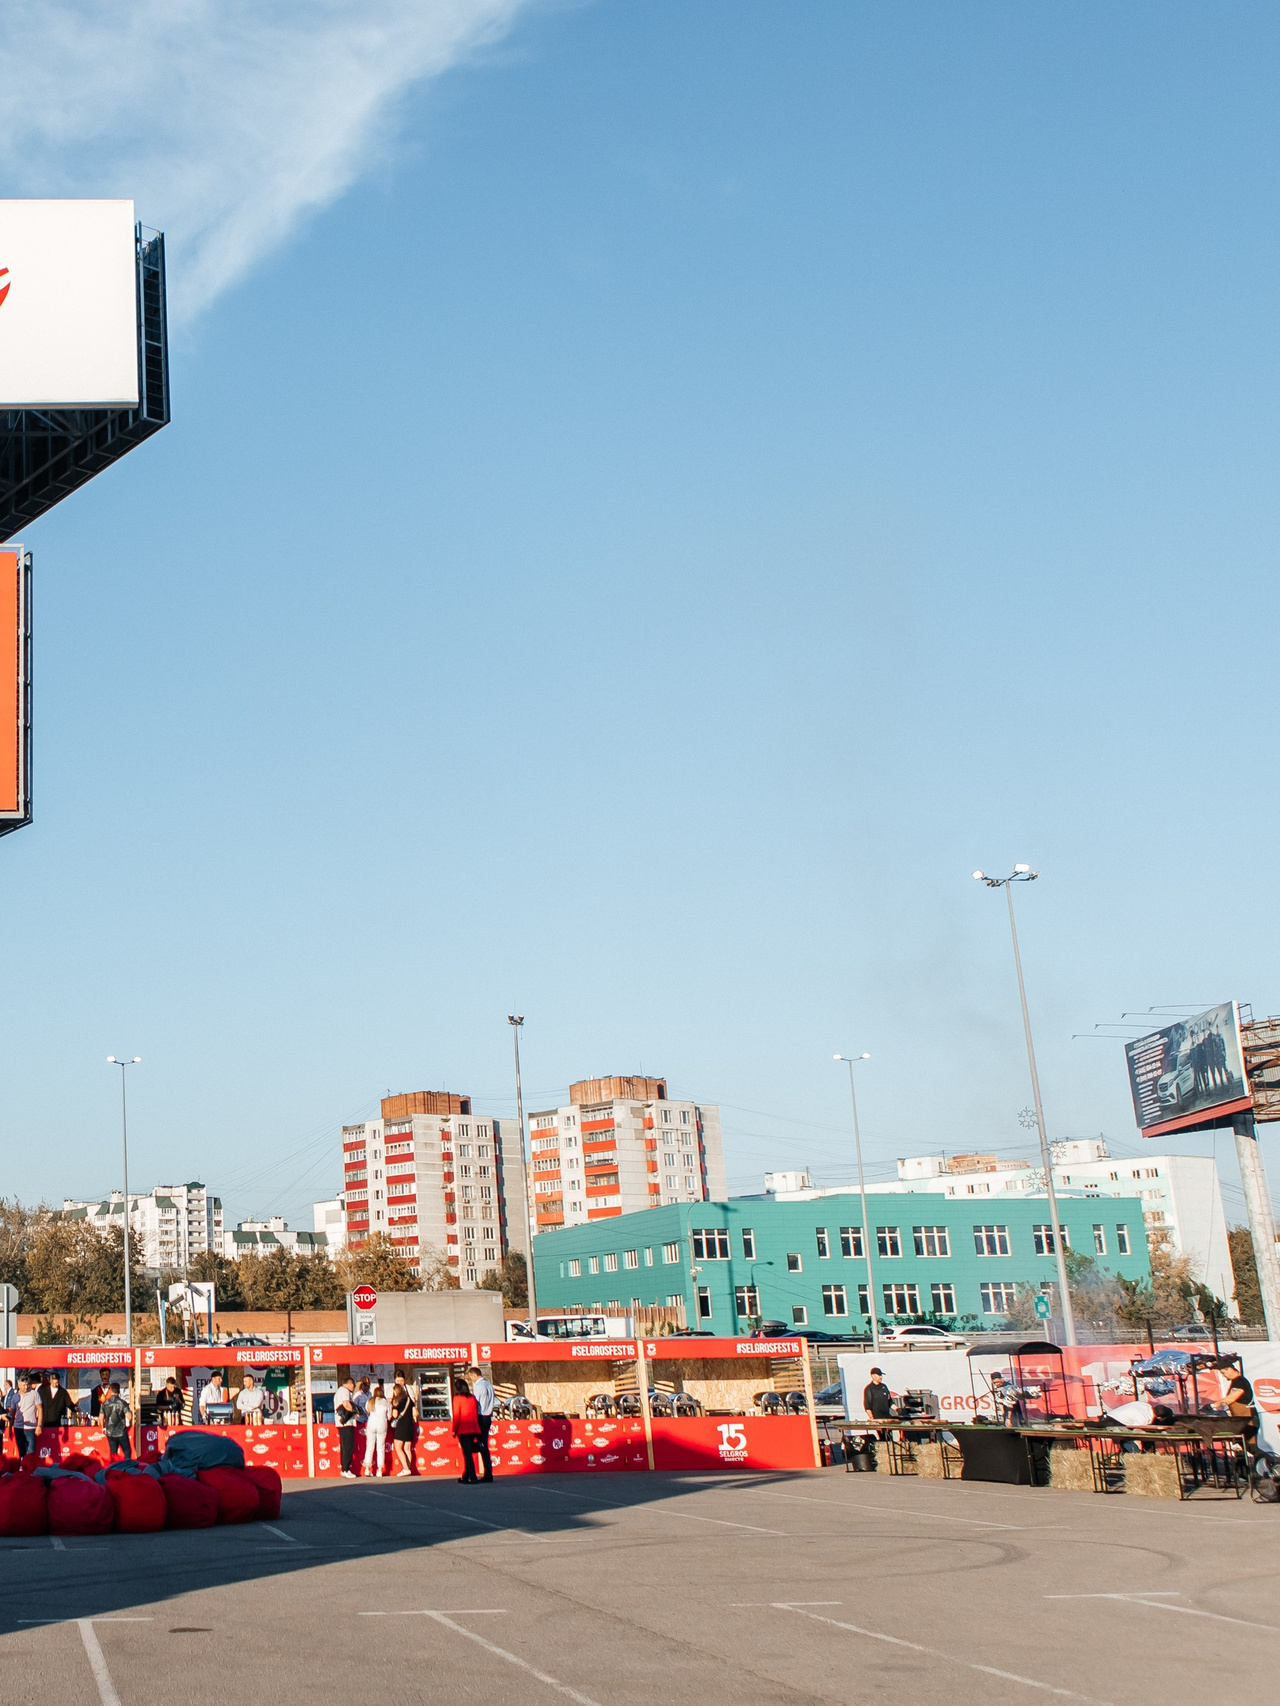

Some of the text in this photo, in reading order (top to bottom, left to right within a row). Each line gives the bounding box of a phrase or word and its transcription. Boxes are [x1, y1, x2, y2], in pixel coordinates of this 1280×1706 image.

[354, 1293, 377, 1302] STOP
[571, 1345, 635, 1357] #SELGROSFEST15
[736, 1341, 800, 1354] #SELGROSFEST15
[67, 1352, 132, 1364] #SELGROSFEST15
[236, 1350, 301, 1363] #SELGROSFEST15
[404, 1348, 468, 1361] #SELGROSFEST15
[717, 1423, 747, 1450] 15
